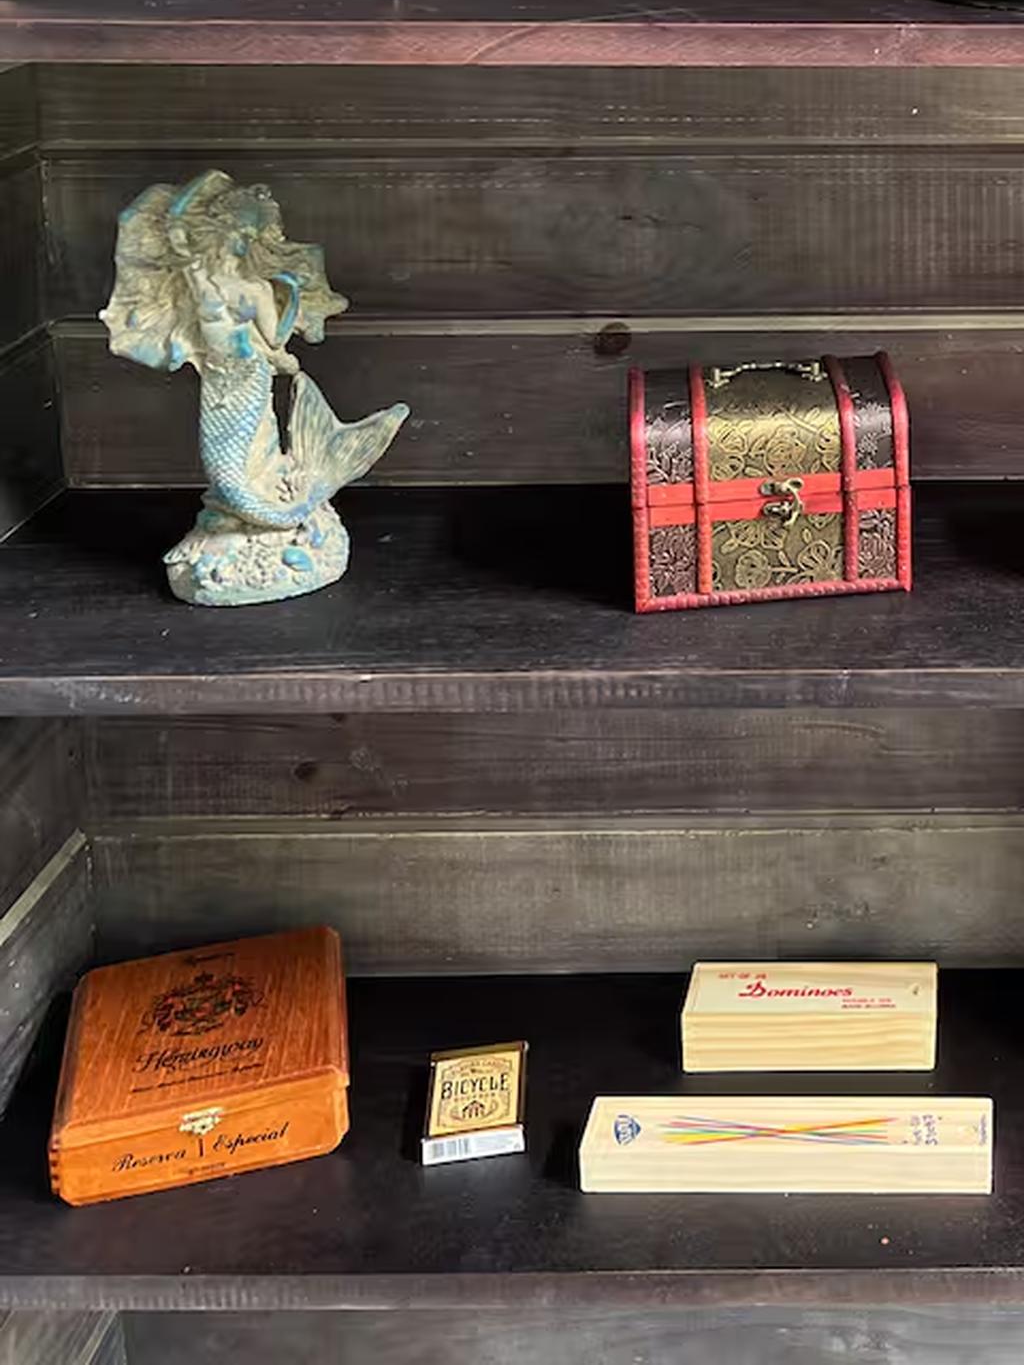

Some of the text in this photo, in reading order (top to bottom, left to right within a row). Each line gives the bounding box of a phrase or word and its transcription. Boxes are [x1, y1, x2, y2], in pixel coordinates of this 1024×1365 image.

[738, 981, 854, 998] Dominoes
[441, 1072, 510, 1100] BICYCLE
[112, 1151, 187, 1172] Reserva
[213, 1121, 290, 1155] Especial
